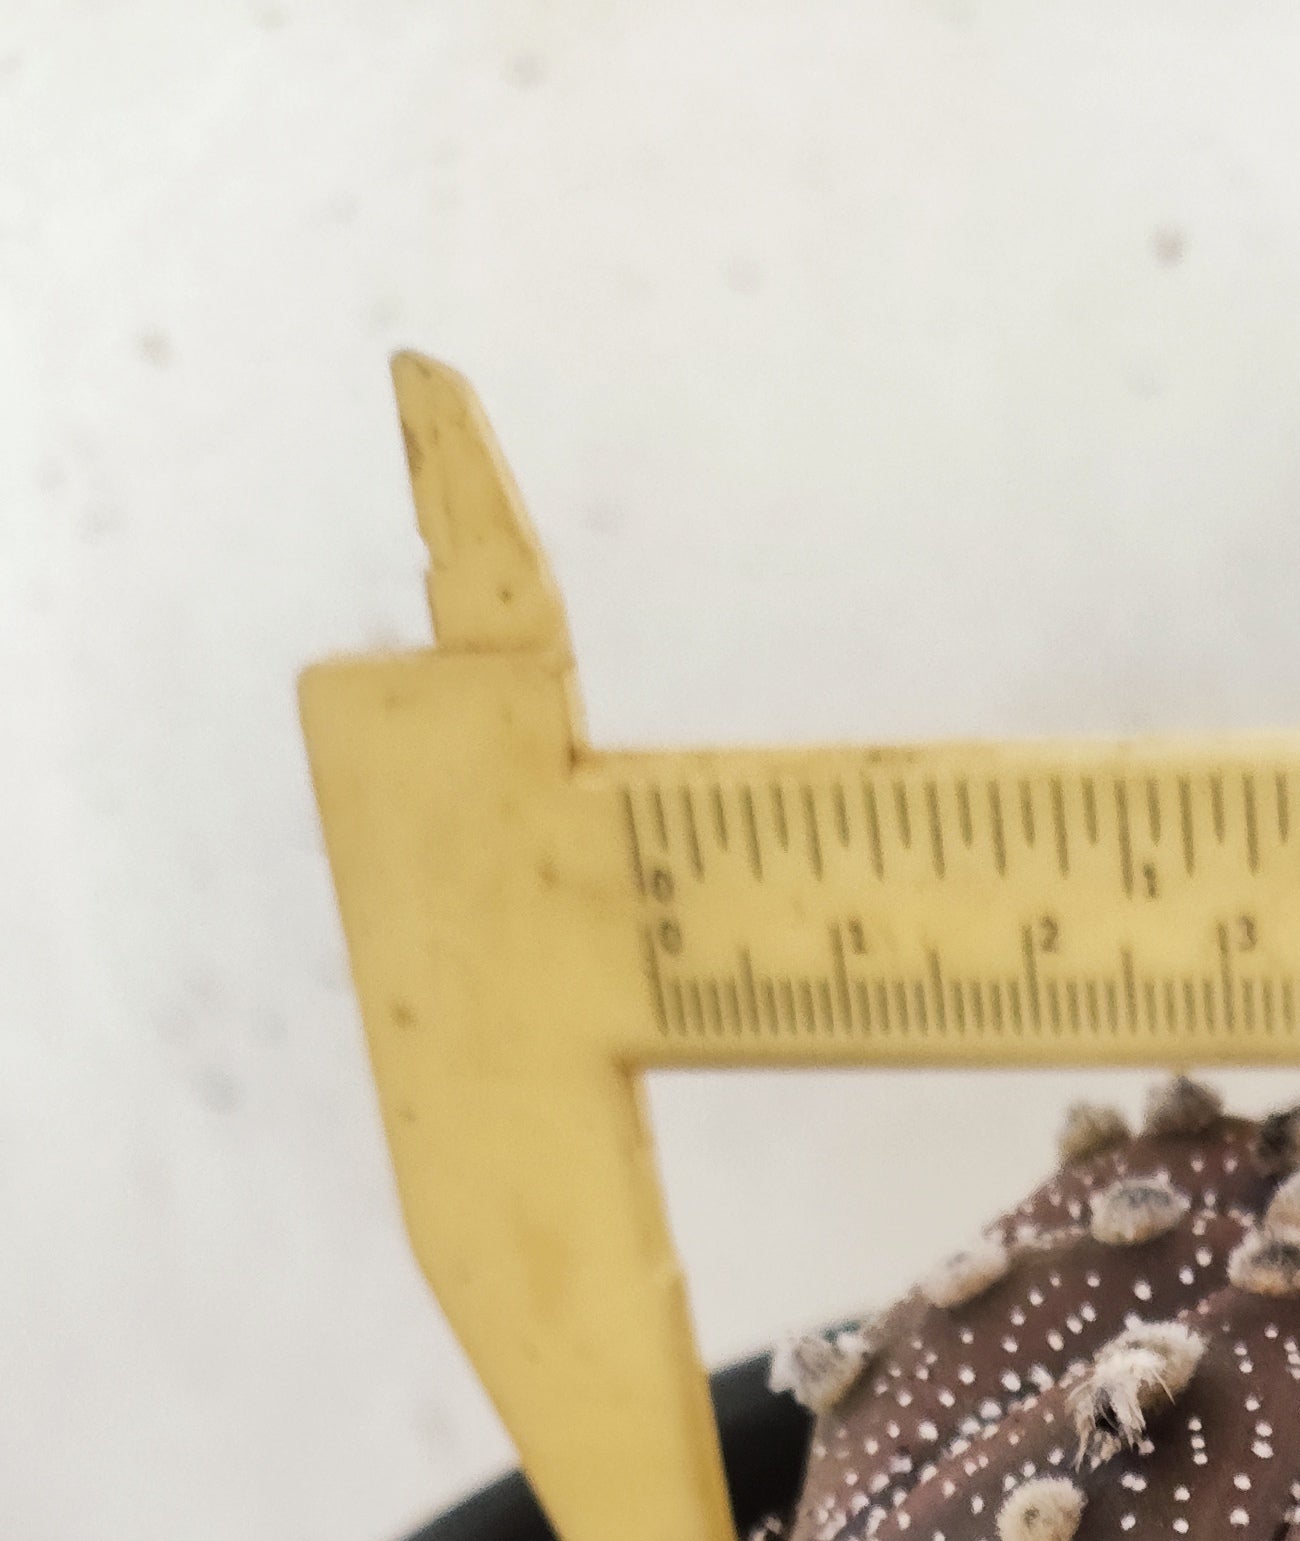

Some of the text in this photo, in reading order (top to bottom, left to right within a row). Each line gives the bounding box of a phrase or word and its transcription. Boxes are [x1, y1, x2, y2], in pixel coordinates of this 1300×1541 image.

[652, 866, 676, 902] 0
[1140, 863, 1160, 899] 1
[657, 917, 684, 955] 0
[846, 916, 869, 956] 1
[1038, 915, 1060, 953] 2
[1237, 914, 1258, 952] 3
